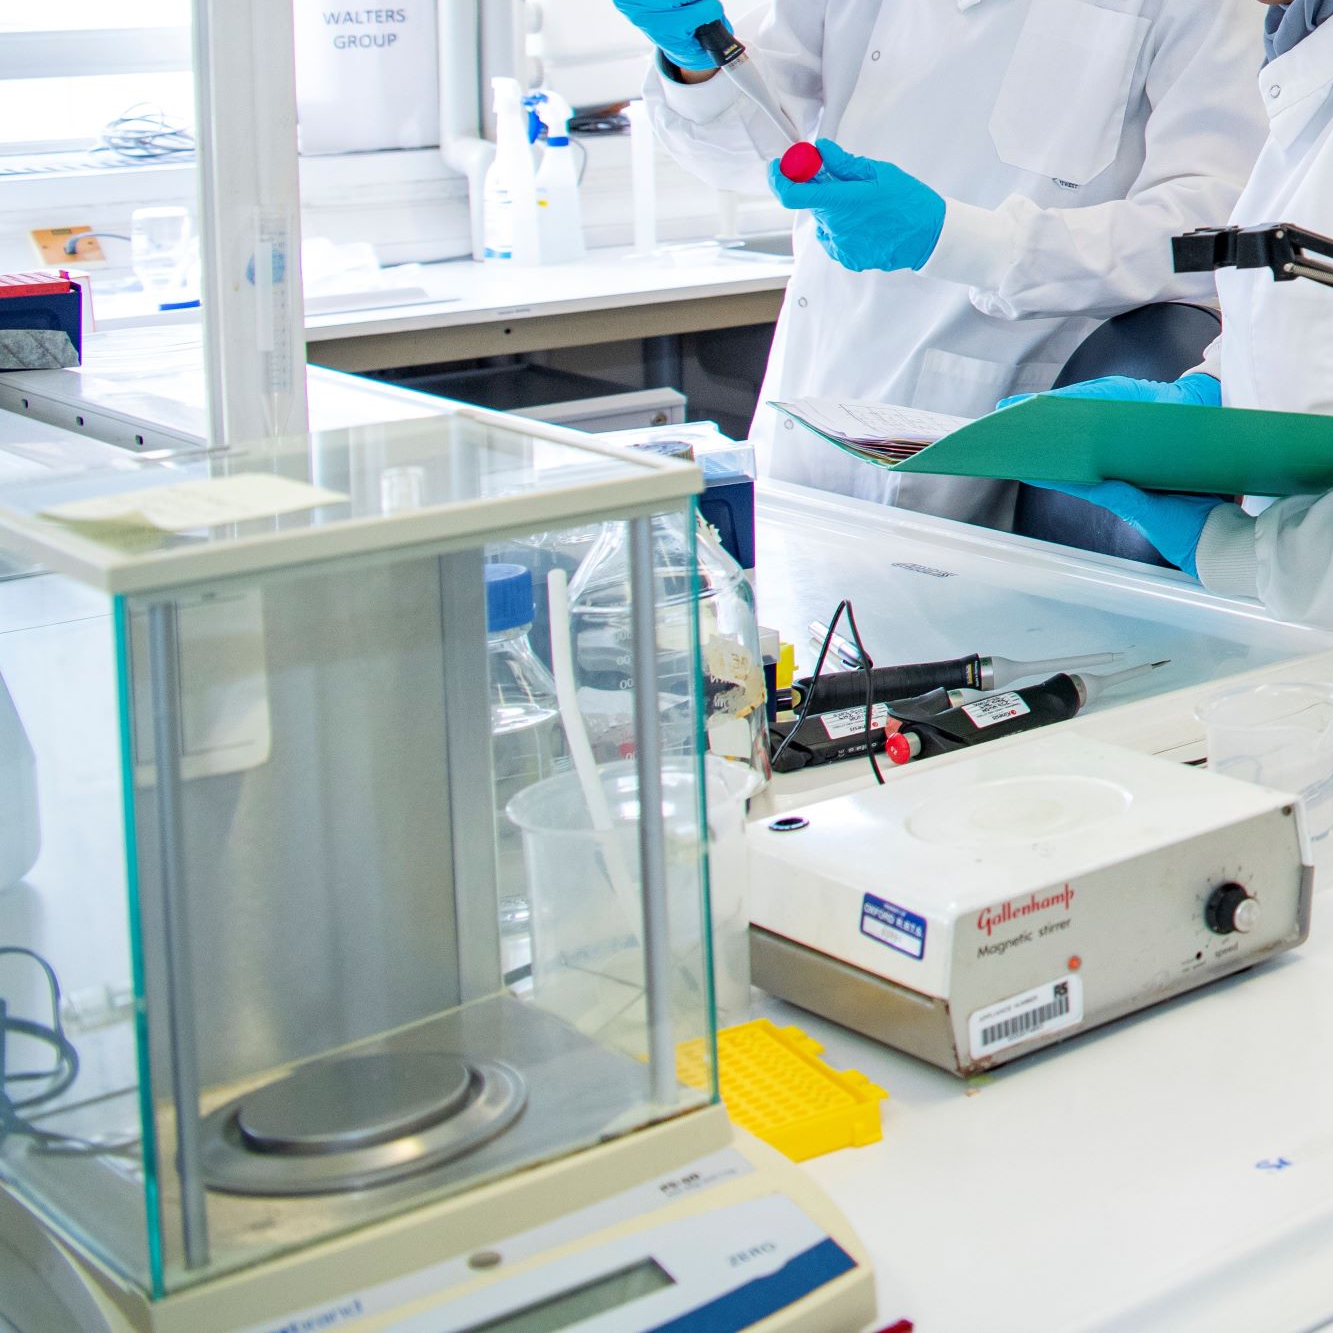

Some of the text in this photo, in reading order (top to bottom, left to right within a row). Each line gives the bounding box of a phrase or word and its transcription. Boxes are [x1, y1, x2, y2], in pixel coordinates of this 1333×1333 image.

[323, 8, 406, 26] WALTERS
[333, 32, 398, 50] GROUP
[976, 918, 1072, 959] Magnetic stirrer
[728, 1242, 776, 1268] ZERO
